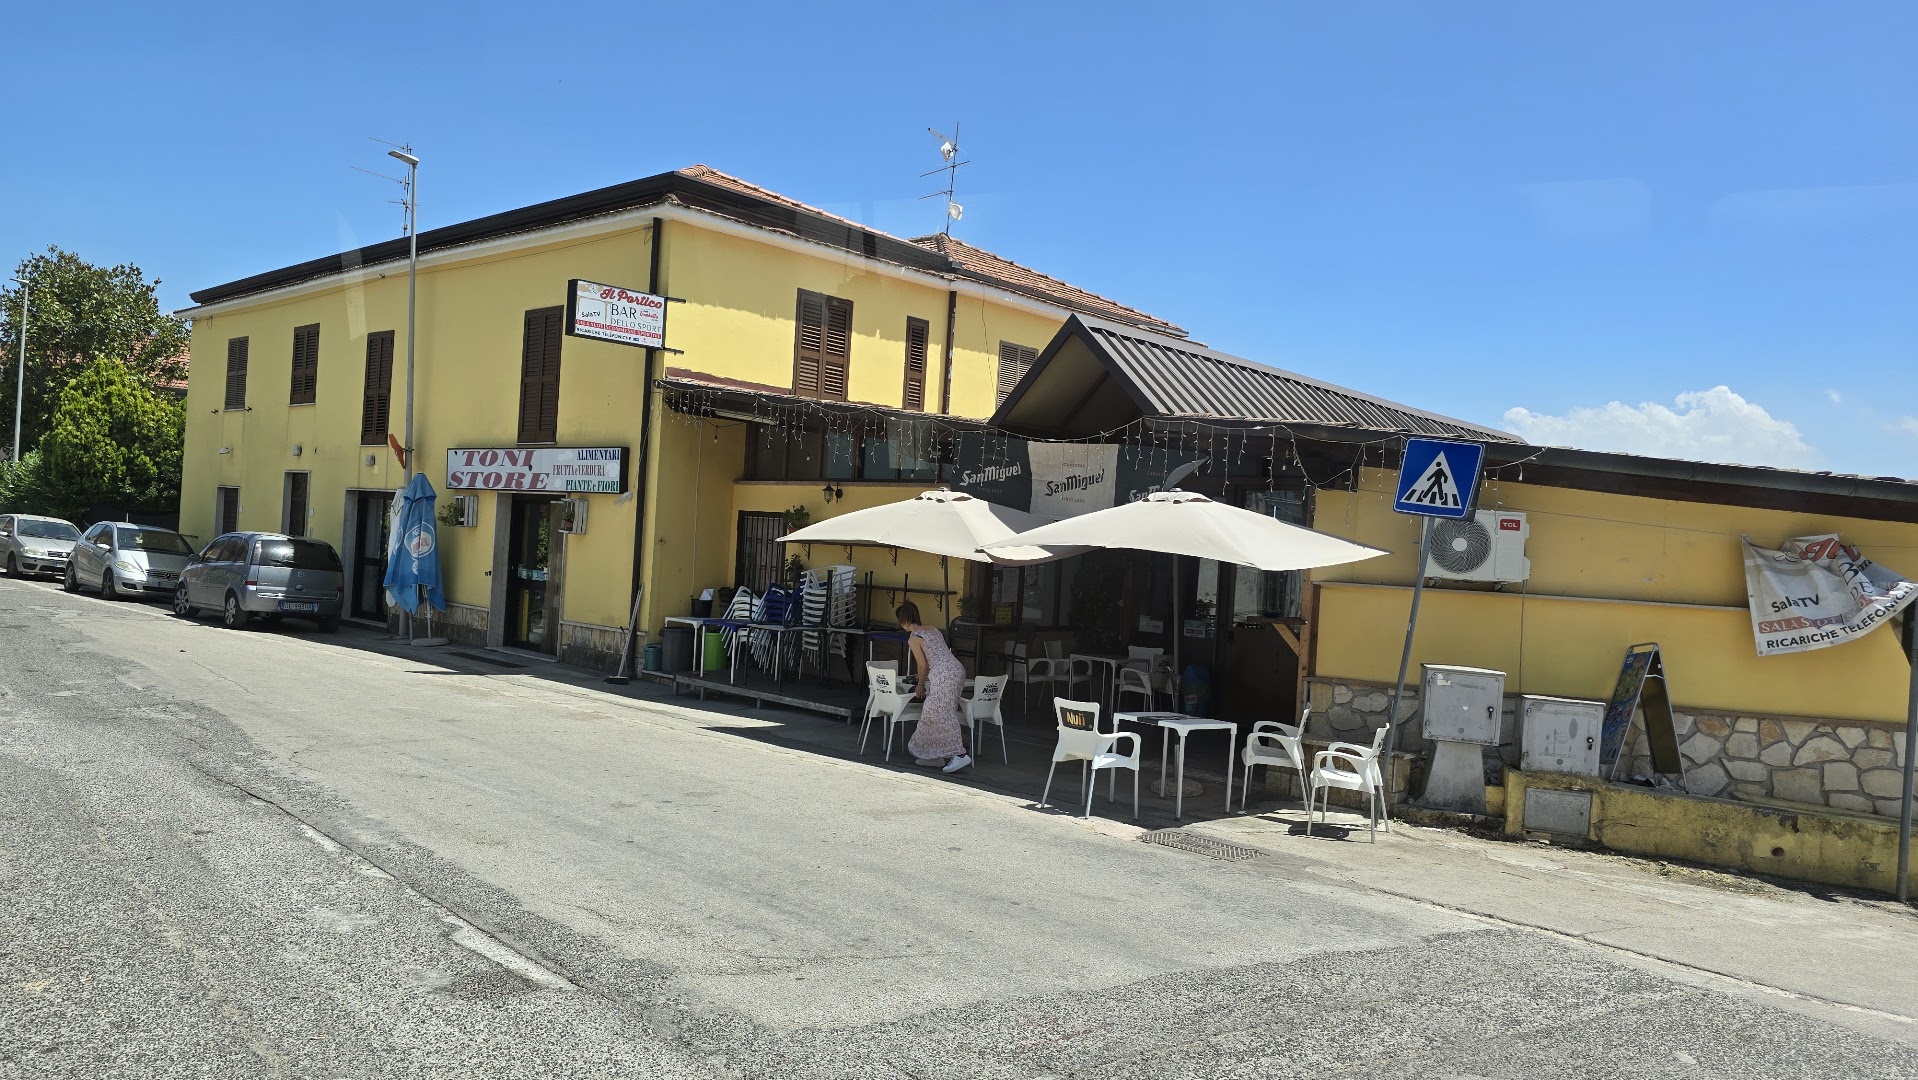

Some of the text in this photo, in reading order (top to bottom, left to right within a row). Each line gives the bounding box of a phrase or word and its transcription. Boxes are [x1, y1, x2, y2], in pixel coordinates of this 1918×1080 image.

[600, 287, 663, 309] Il Portico
[611, 303, 637, 320] BAR
[610, 317, 662, 333] DELLO SPORT
[462, 449, 537, 467] TONI
[576, 449, 620, 461] ALIMENTARI
[448, 470, 551, 489] STORE
[565, 479, 593, 492] PIANTE
[597, 480, 619, 492] FIORI
[1771, 594, 1820, 613] SalaTV
[1761, 620, 1799, 633] SALA
[1766, 630, 1839, 649] RICARICHE
